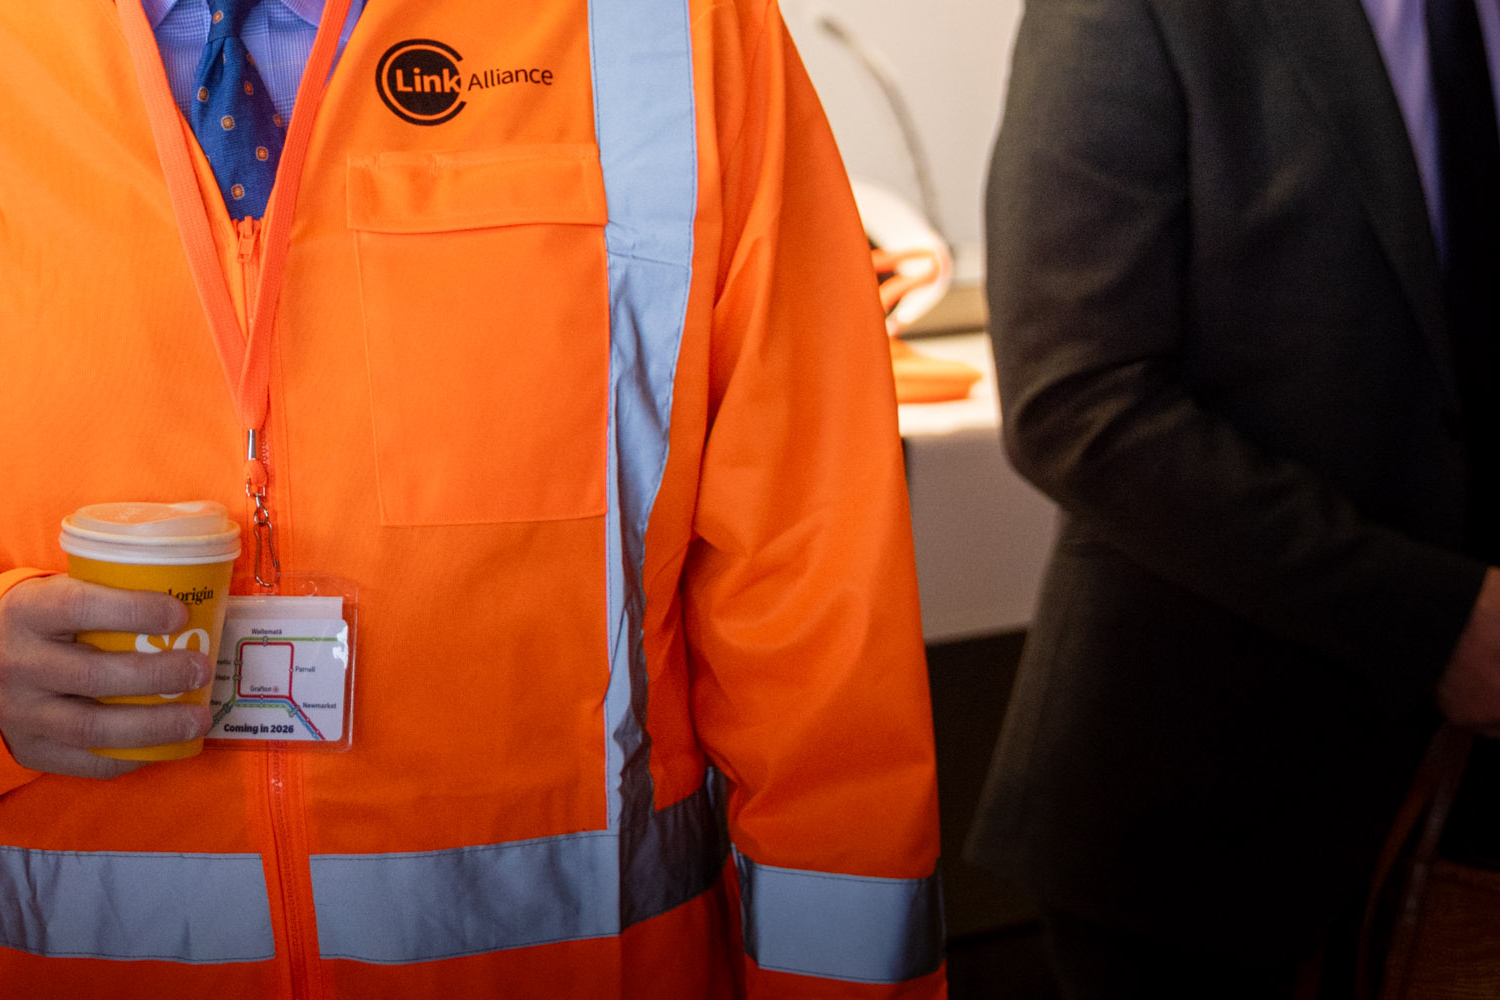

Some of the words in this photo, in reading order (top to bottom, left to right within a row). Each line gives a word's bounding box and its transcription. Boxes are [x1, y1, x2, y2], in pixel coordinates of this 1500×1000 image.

[395, 67, 462, 93] Link
[467, 67, 554, 91] Alliance
[176, 587, 214, 605] origin
[223, 723, 259, 735] Coming
[260, 723, 269, 733] in
[270, 724, 294, 733] 2026
